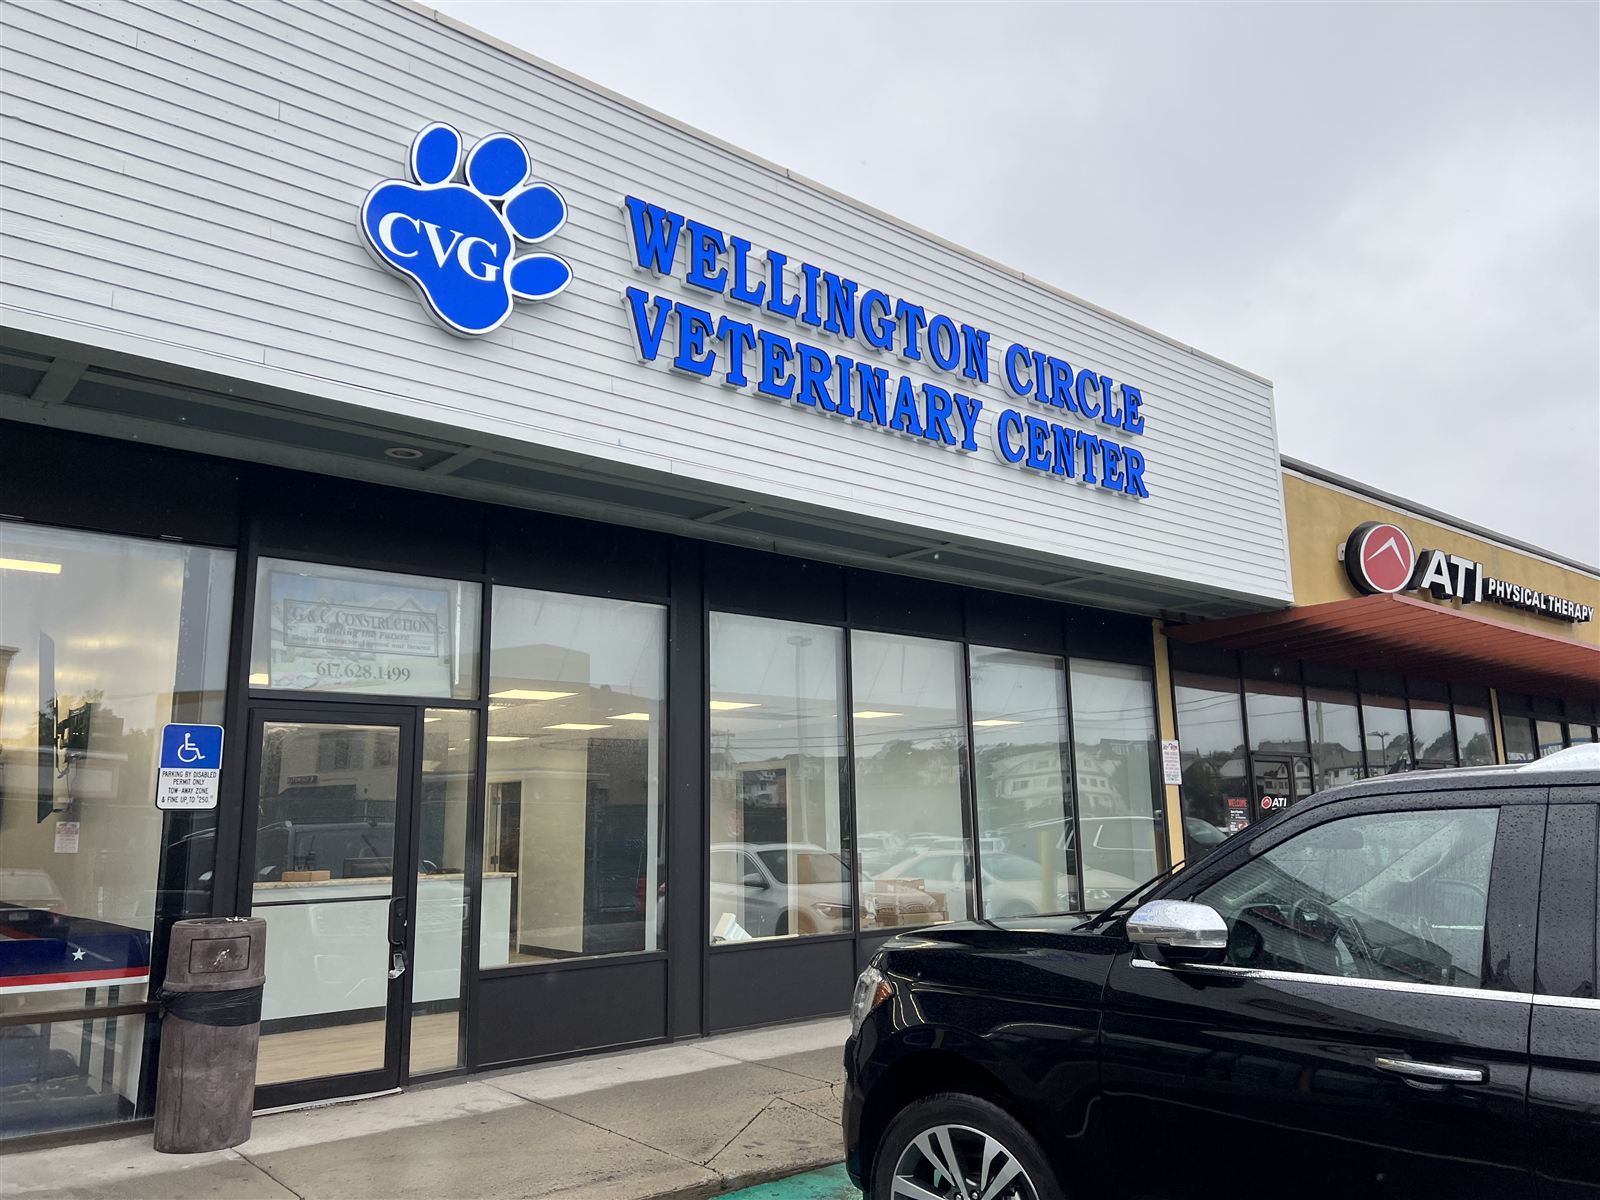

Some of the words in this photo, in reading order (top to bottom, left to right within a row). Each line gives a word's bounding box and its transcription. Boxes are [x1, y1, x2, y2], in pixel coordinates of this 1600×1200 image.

[378, 212, 500, 282] CVG
[624, 194, 991, 384] WELLINGTON
[1003, 342, 1145, 436] CIRCLE
[625, 285, 984, 452] VETERINARY
[997, 408, 1150, 499] CENTER
[1420, 549, 1484, 604] ATI
[1488, 577, 1547, 610] PHYSICAL
[1548, 596, 1595, 622] THERAPY
[335, 610, 430, 632] CONSTRUCTION
[315, 661, 411, 681] 617.628.1499
[161, 770, 184, 778] PARKING
[193, 771, 217, 779] DISABLED
[172, 778, 191, 786] PERMIT
[192, 778, 205, 786] ONLY
[195, 787, 209, 795] ZONE
[1227, 798, 1248, 807] WELCOME
[1271, 797, 1287, 807] ATI
